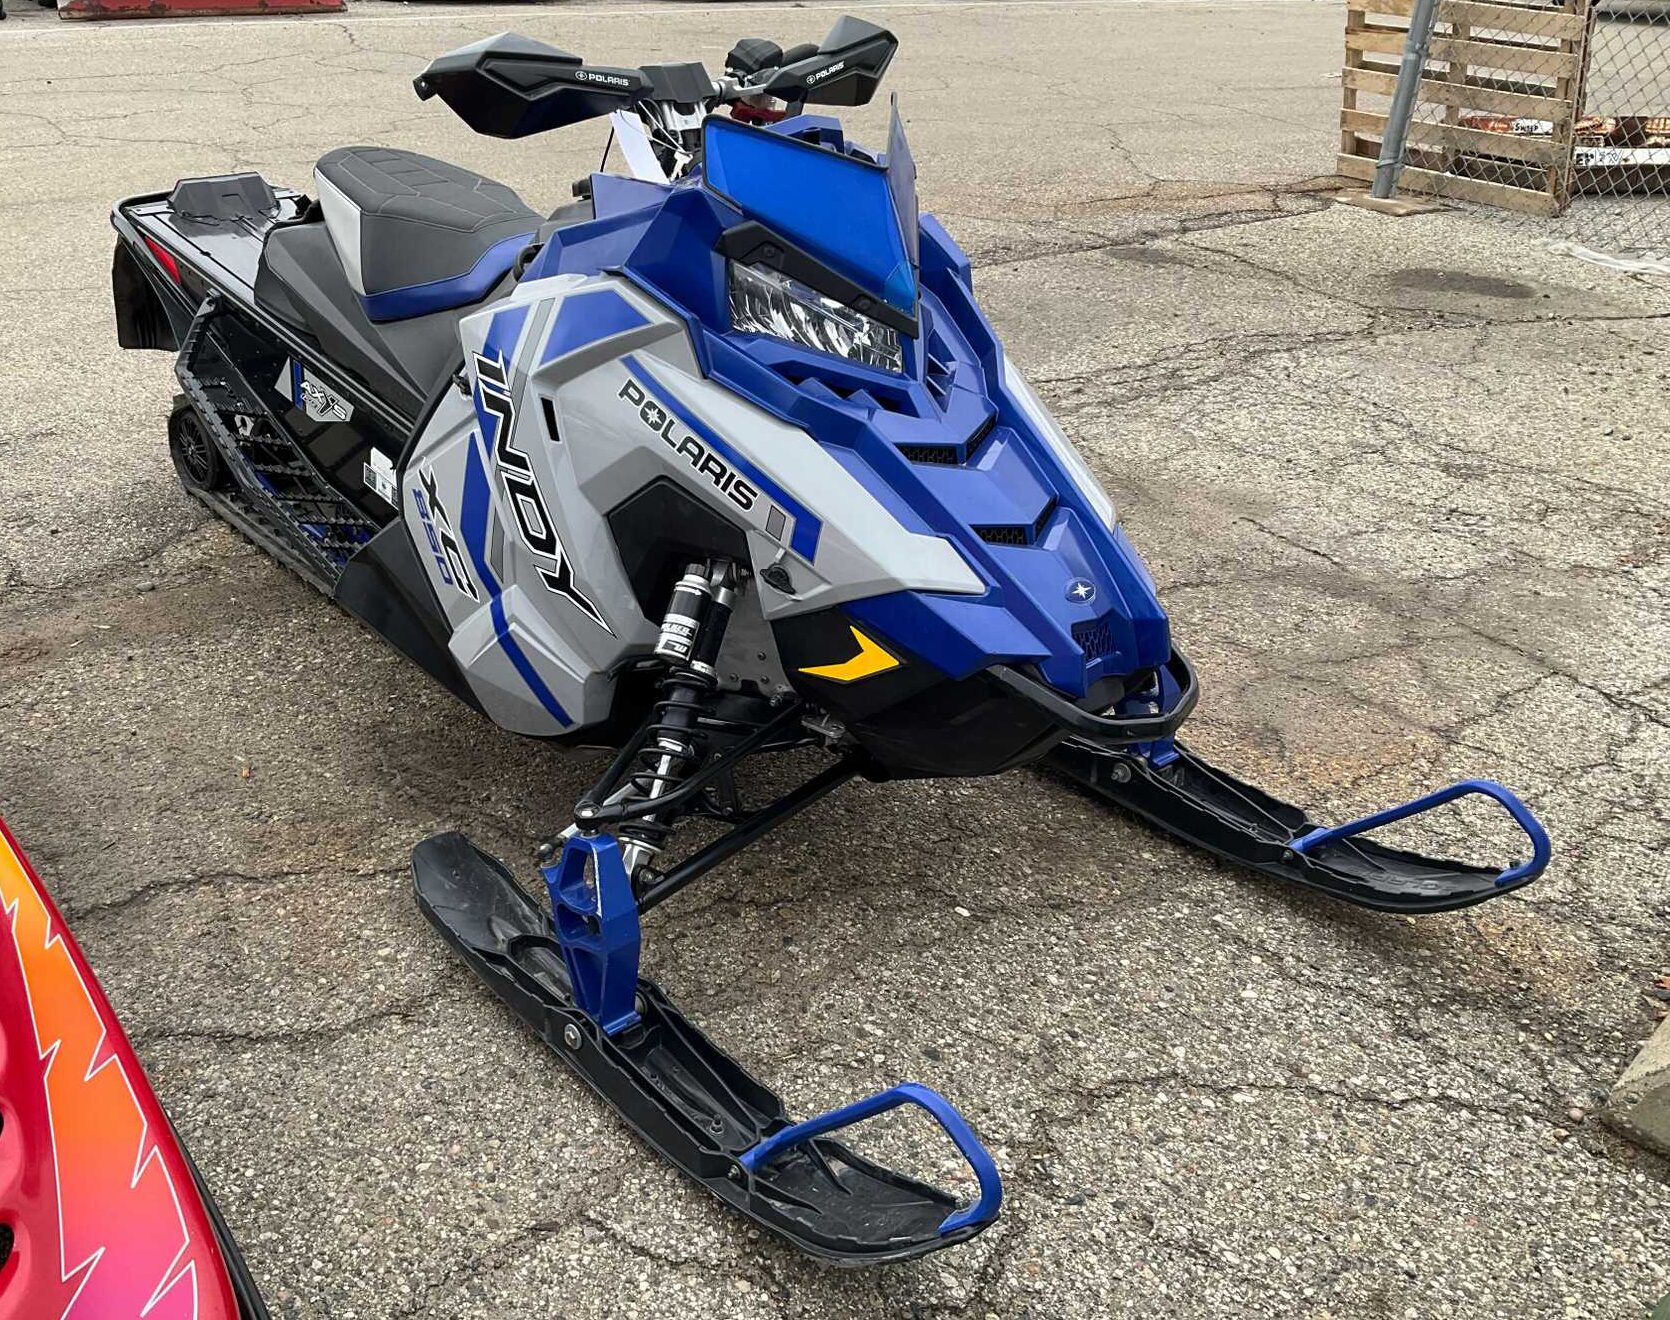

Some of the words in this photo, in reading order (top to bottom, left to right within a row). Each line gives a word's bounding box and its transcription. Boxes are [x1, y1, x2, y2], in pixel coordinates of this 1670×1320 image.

[588, 73, 630, 87] POLARIS
[815, 60, 845, 80] POLARIS
[472, 350, 617, 640] INDY
[618, 378, 759, 511] POLARIS
[412, 488, 453, 585] 850
[418, 456, 480, 602] XC
